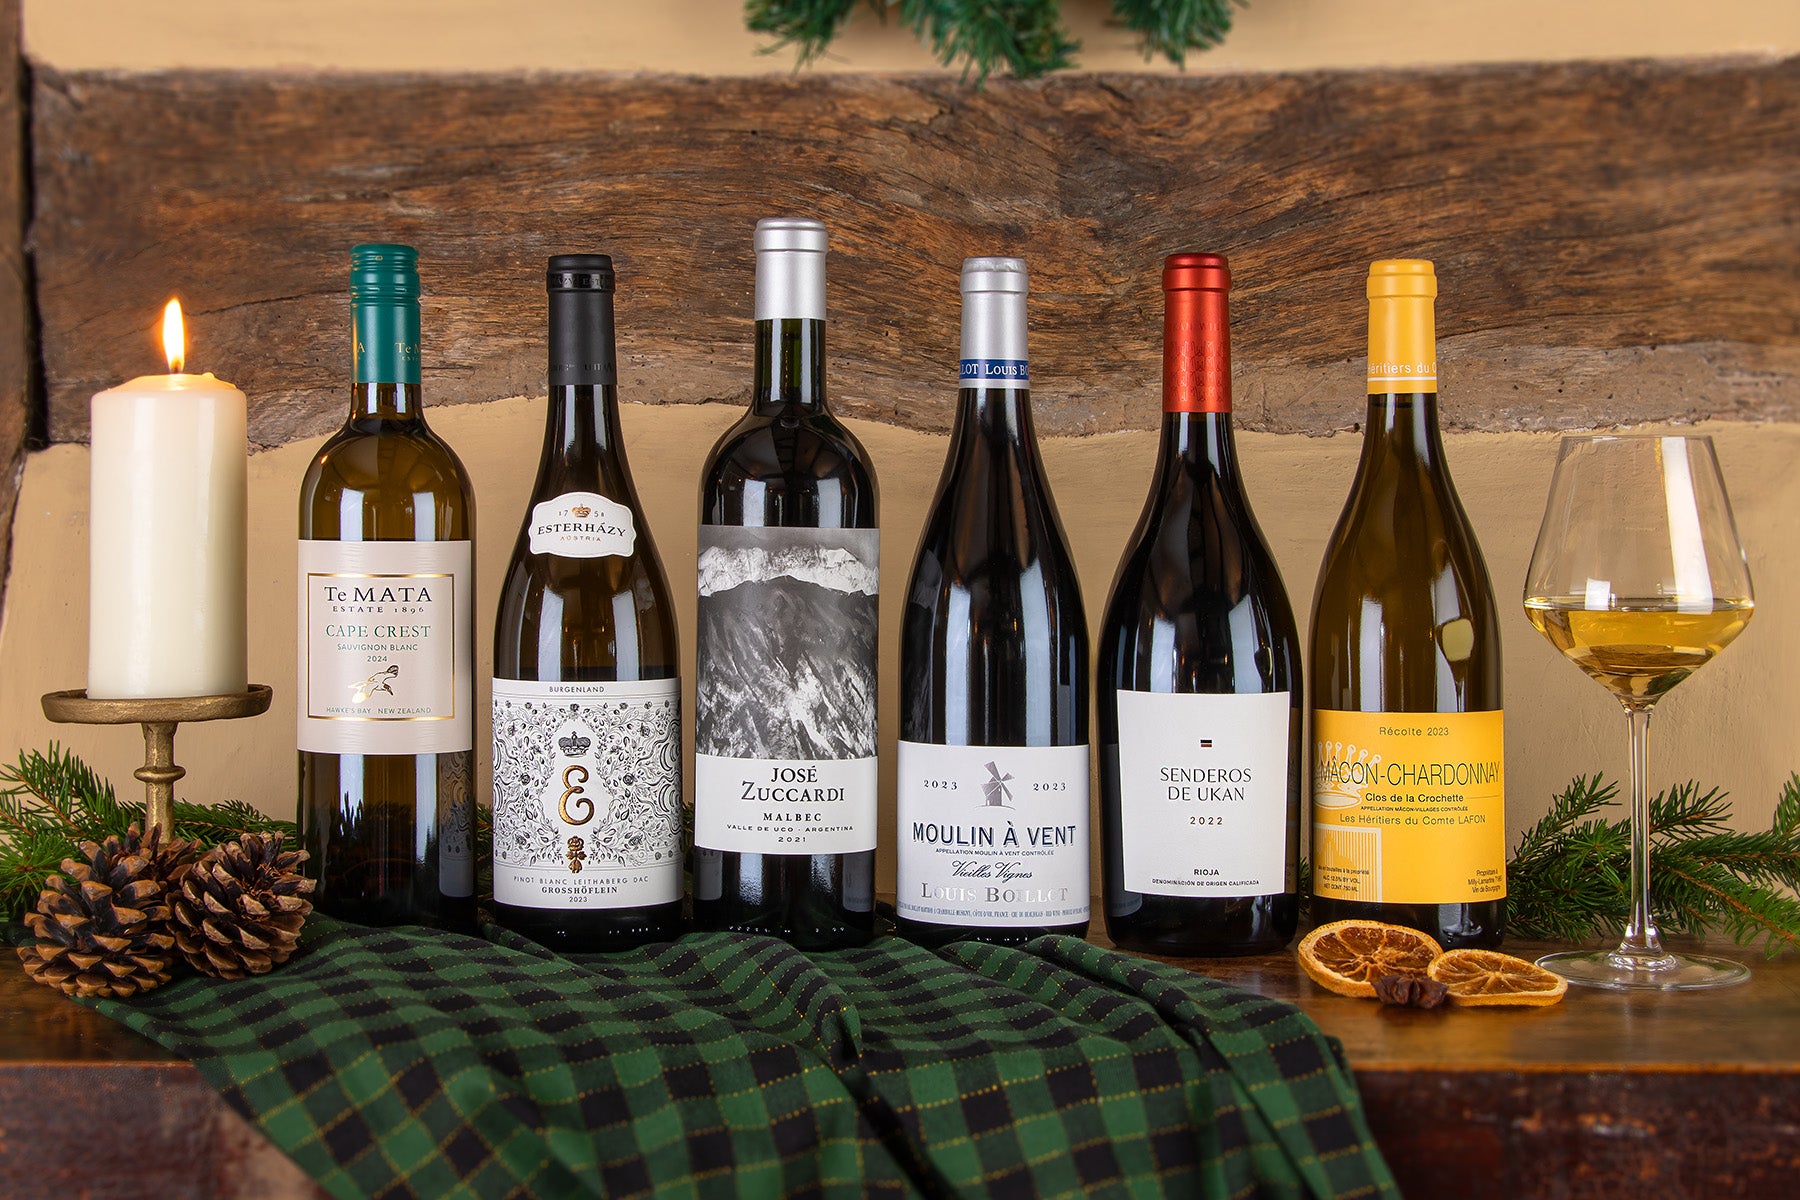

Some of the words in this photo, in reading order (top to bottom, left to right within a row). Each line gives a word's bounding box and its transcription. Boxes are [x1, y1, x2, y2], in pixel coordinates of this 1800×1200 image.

[394, 342, 411, 354] Te
[985, 364, 1017, 375] LOUIS
[1417, 362, 1430, 373] du
[537, 522, 626, 537] ESTERHÁZY
[324, 586, 347, 602] Te
[353, 587, 432, 602] MATA
[326, 624, 368, 638] CAPE
[374, 625, 431, 638] CREST
[1379, 726, 1422, 736] Récolte
[1427, 728, 1448, 736] 2023
[771, 766, 818, 783] JOSÉ
[1160, 767, 1251, 782] SENDEROS
[1320, 756, 1500, 785] MÂCON-CHARDONNAY
[923, 780, 958, 790] 2023
[1033, 782, 1066, 791] 2023
[1168, 786, 1190, 801] DE
[1198, 787, 1244, 801] UKAN
[1365, 793, 1387, 802] Clos
[1390, 794, 1402, 802] de
[1406, 794, 1414, 802] la
[1418, 794, 1464, 802] Crochette
[763, 813, 822, 821] MALBEC
[1190, 816, 1222, 825] 2022
[1340, 814, 1356, 823] Les
[1359, 814, 1401, 824] Héritiers
[1405, 816, 1418, 825] du
[1422, 816, 1455, 825] Comte
[1458, 815, 1486, 824] LAFON
[912, 822, 994, 847] MOULIN
[1003, 820, 1019, 848] À
[1027, 825, 1076, 847] VENT
[952, 860, 992, 878] Vieilles
[995, 862, 1032, 883] Vignes
[542, 885, 618, 894] GROSSHÖFLEIN
